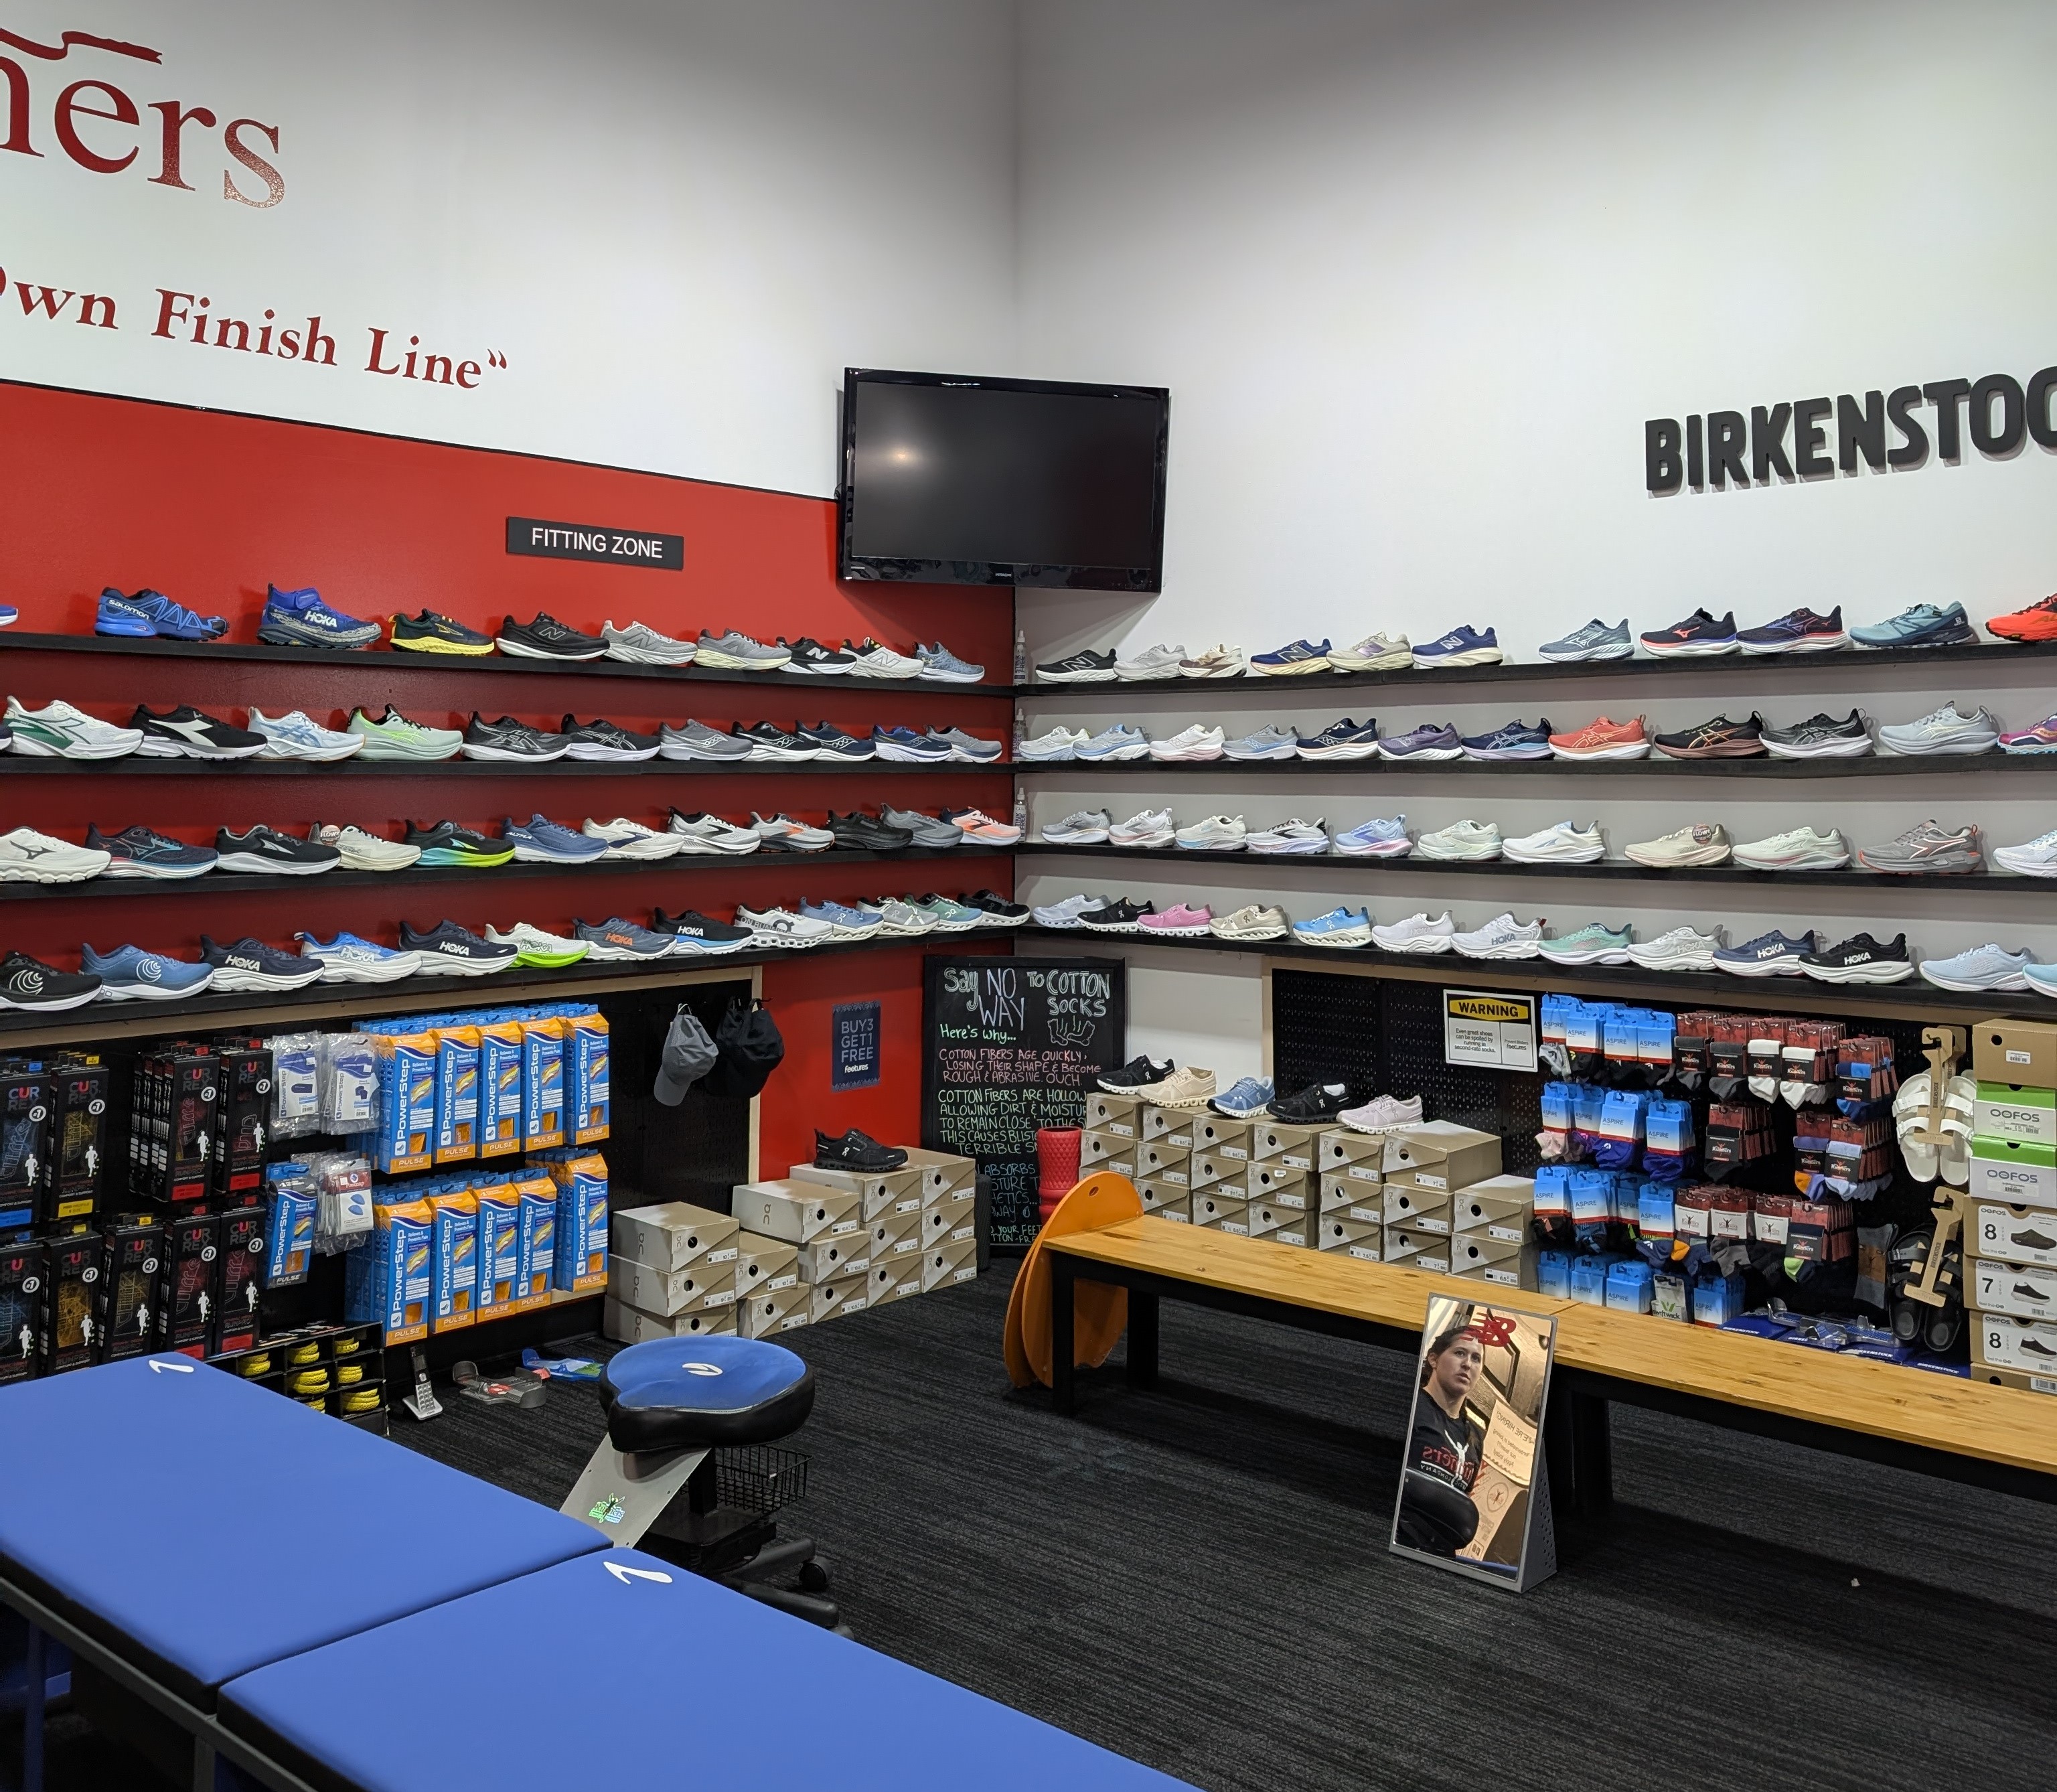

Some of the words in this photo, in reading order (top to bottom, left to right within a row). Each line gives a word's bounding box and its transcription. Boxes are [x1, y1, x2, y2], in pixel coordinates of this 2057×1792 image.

[0, 267, 119, 329] wn
[151, 289, 337, 366] Finish
[532, 528, 607, 552] FITTING
[611, 536, 663, 559] ZONE
[305, 610, 338, 628] HOKA
[678, 925, 704, 937] HOKA
[605, 932, 633, 946] HOKA
[1491, 933, 1517, 946] HOKA
[439, 940, 470, 956] HOKA
[1677, 940, 1705, 954] HOKA
[1757, 942, 1786, 959] HOKA
[339, 946, 376, 964] HOKA
[1844, 952, 1872, 966] HOKA
[224, 954, 261, 972] HOKA
[943, 968, 979, 1011] Say
[987, 968, 1016, 999] NO
[1046, 969, 1110, 999] COTTON
[978, 994, 1024, 1031] WAY
[1047, 996, 1107, 1017] SOCKS
[1458, 1002, 1519, 1017] WARNING
[939, 1023, 978, 1039] Here's
[841, 1046, 874, 1063] FREE
[939, 1049, 976, 1061] COTTON
[980, 1049, 1014, 1061] FIBERS
[1018, 1049, 1037, 1061] AGE
[844, 1063, 869, 1073] feetures
[946, 1060, 984, 1071] LOSING
[1014, 1061, 1049, 1073] SHAPE
[943, 1070, 982, 1083] ROUGH
[938, 1088, 983, 1104] COTTON
[985, 1088, 1018, 1103] FIBERS
[1022, 1089, 1043, 1102] ARE
[940, 1104, 998, 1116] ALLOWING
[1000, 1102, 1027, 1115] DIRT
[1990, 1108, 2040, 1122] OOFOS
[939, 1116, 954, 1130] TO
[957, 1116, 998, 1130] REMAIN
[998, 1115, 1031, 1130] CLOSE
[1602, 1117, 1624, 1125] ASPIRE
[939, 1130, 966, 1143] THIS
[968, 1130, 1007, 1142] CAUSES
[1648, 1130, 1669, 1138] ASPIRE
[955, 1142, 1022, 1156] TERRIBLE
[984, 1163, 1036, 1177] ABSORBS
[1987, 1169, 2038, 1183] OOFOS
[1981, 1207, 2006, 1216] OOFOS
[997, 1224, 1019, 1236] YOUR
[1984, 1223, 1997, 1240] 8
[1978, 1261, 2003, 1270] OOFOS
[1572, 1284, 1592, 1294] ASPIRE
[1982, 1277, 1994, 1294] 7
[1608, 1292, 1629, 1301] ASPIRE
[1985, 1316, 2011, 1325] OOFOS
[1989, 1332, 2001, 1349] 8
